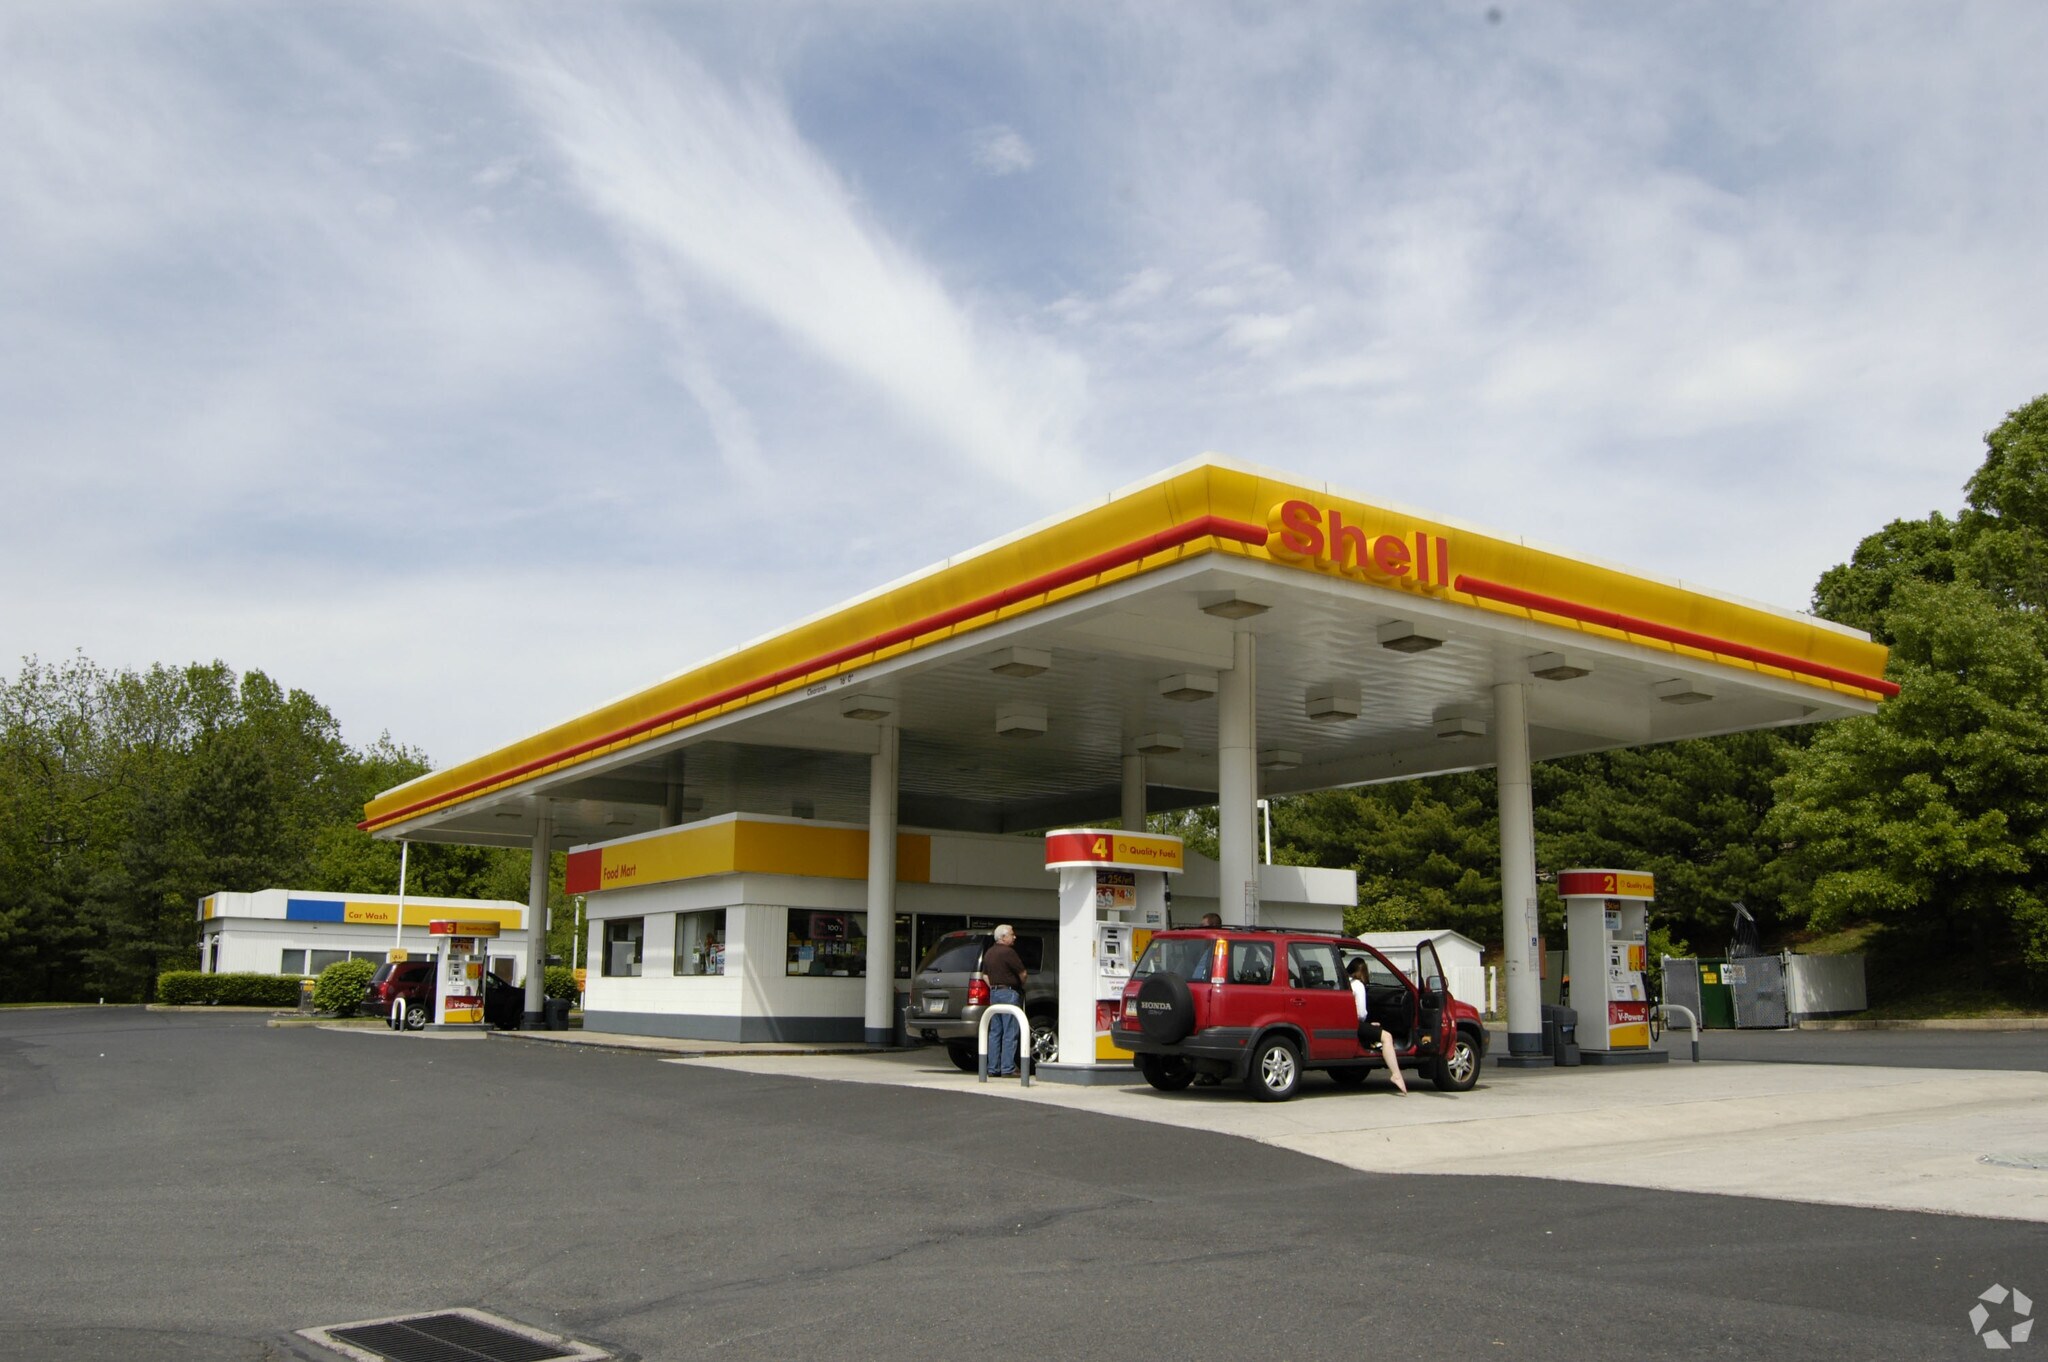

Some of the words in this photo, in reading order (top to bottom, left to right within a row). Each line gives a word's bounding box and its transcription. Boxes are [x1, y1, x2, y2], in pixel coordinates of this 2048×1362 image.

[1273, 499, 1449, 589] Shell
[1092, 838, 1107, 857] 4
[1130, 846, 1157, 857] Quality
[1159, 850, 1177, 859] Fuels
[603, 864, 619, 881] Food
[620, 863, 637, 878] Mart
[1603, 875, 1615, 892] 2
[1627, 882, 1642, 890] Quality
[348, 911, 363, 919] Car
[365, 912, 388, 920] Wash
[447, 923, 454, 933] 5
[1141, 1001, 1172, 1011] HONDA
[1617, 1012, 1645, 1022] V-Power
